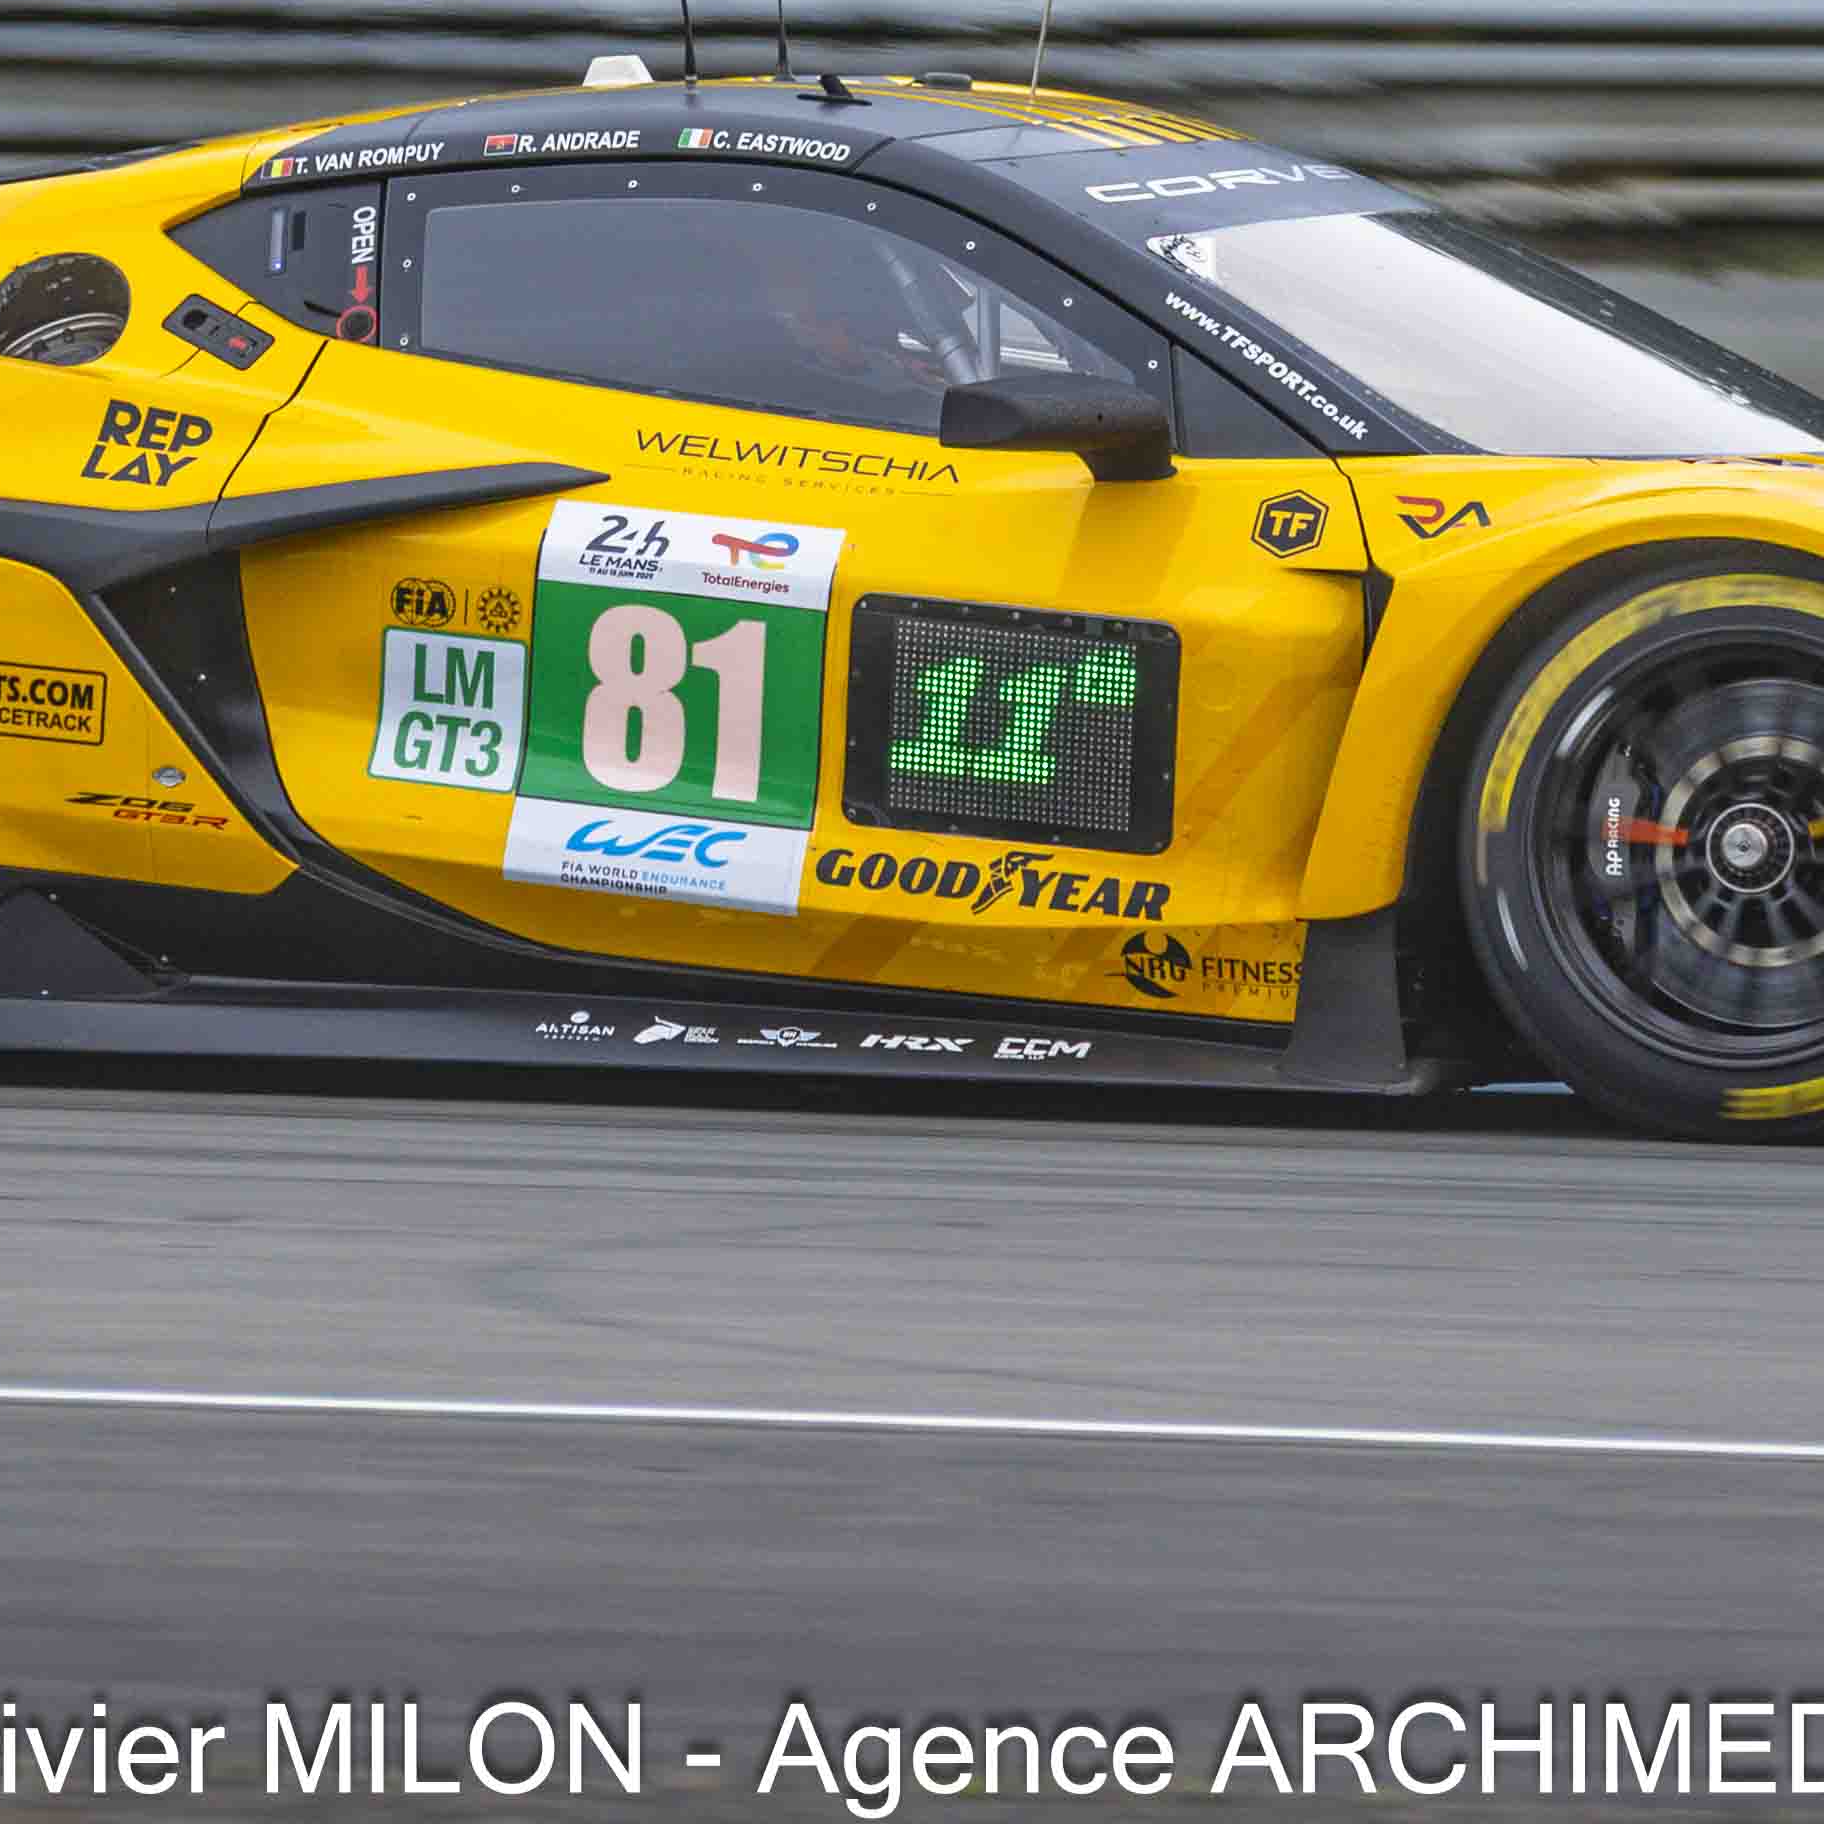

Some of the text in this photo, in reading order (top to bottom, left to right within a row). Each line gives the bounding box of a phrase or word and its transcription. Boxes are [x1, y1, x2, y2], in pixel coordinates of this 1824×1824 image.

[296, 142, 445, 174] T. VAN ROMPUY
[518, 130, 641, 152] R. ANDRADE
[713, 131, 851, 163] C. EASTWOOD
[351, 205, 376, 264] OPEN
[1165, 291, 1369, 441] www.TFSPORT.co.uk
[97, 398, 213, 453] REP
[80, 444, 199, 487] LAY
[636, 429, 961, 484] WELWITSCHIA
[1269, 509, 1315, 539] TF
[578, 552, 660, 574] LE MANS
[701, 570, 791, 595] TotalEnergies
[413, 643, 496, 710] LM
[582, 603, 768, 803] 81
[393, 709, 504, 777] GT3
[564, 818, 749, 869] WEC
[560, 860, 727, 891] FIA WORLD ENDURANCE
[814, 849, 1172, 922] GOODYEAR
